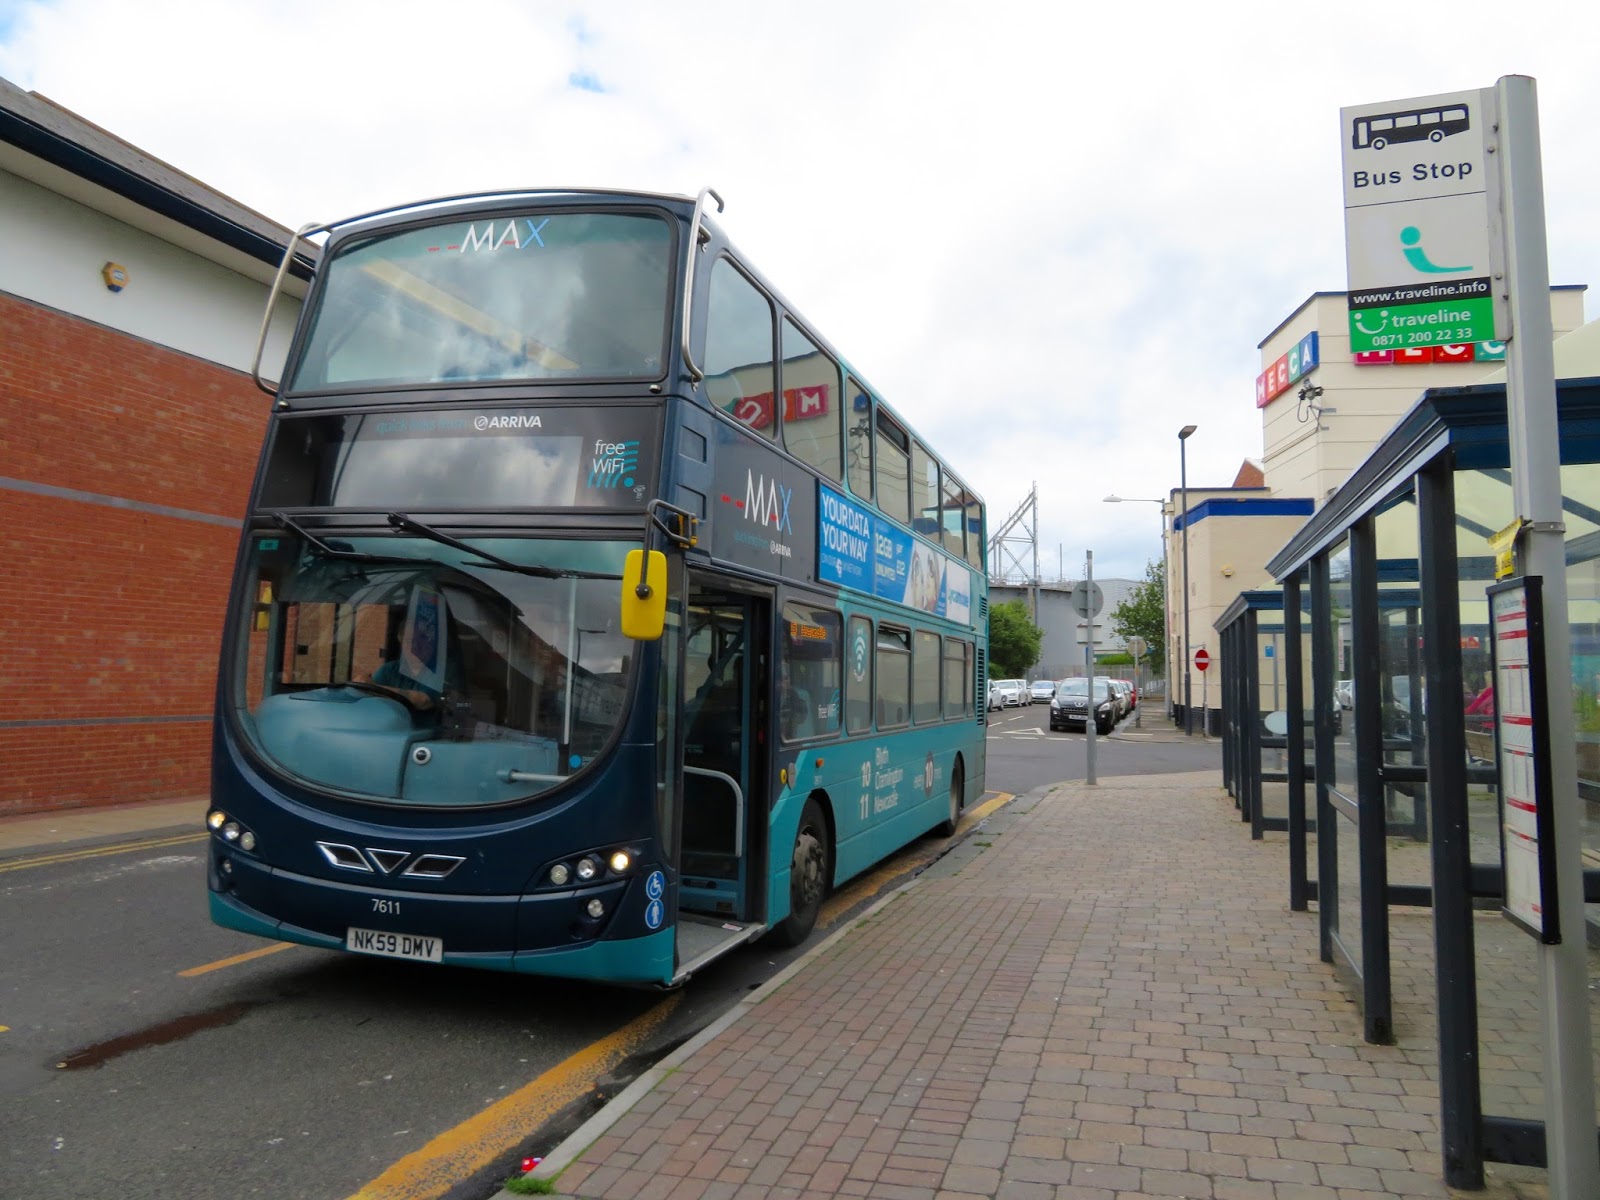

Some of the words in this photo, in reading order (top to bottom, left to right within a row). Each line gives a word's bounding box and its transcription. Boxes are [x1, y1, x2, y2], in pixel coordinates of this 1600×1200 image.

[1353, 170, 1401, 189] Bus
[1412, 161, 1473, 182] Stop
[459, 218, 550, 254] MAX
[1352, 281, 1488, 305] www.traveline.info
[1391, 309, 1472, 328] traveline
[1371, 333, 1404, 347] 0871
[1407, 331, 1432, 344] 200
[1436, 329, 1452, 342] 22
[1455, 327, 1473, 340] 33
[1257, 342, 1312, 402] MECCA
[488, 415, 543, 429] ARRIVA
[594, 439, 626, 455] free
[592, 457, 625, 474] WiFi
[743, 467, 793, 536] MAX
[821, 492, 848, 528] YOUR
[848, 507, 871, 539] DATA
[821, 521, 848, 556] YOUR
[848, 535, 869, 563] WAY
[818, 703, 827, 719] free
[861, 760, 871, 788] 10
[925, 760, 934, 789] 10
[860, 793, 869, 821] 11
[371, 898, 400, 915] 7611
[353, 930, 397, 953] NK59
[401, 936, 435, 958] DMV
